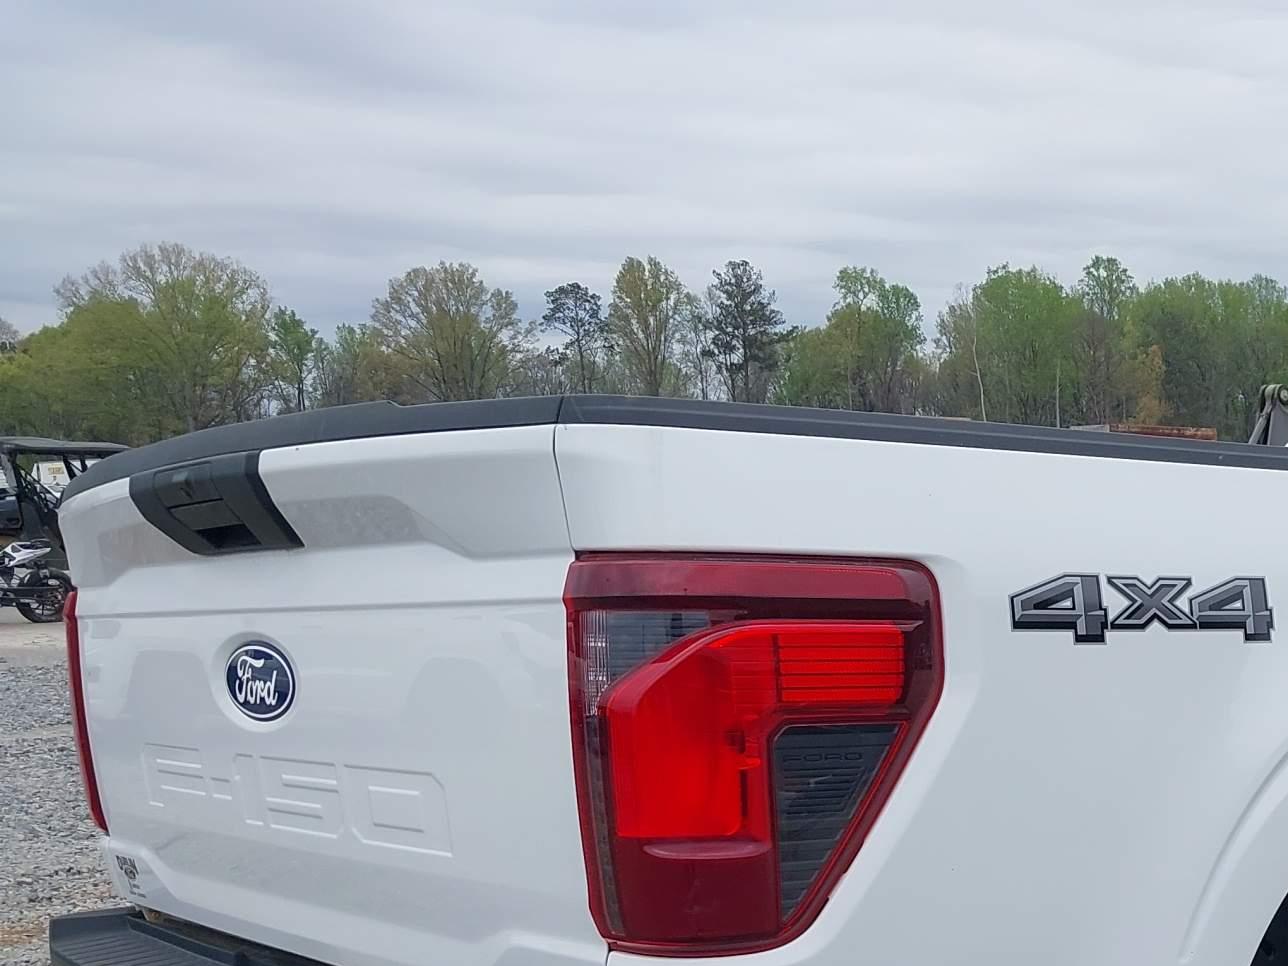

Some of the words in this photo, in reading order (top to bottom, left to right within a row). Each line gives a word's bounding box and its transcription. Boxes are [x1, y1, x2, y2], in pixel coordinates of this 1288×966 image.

[1009, 573, 1275, 645] 4X4
[236, 655, 278, 706] Ford
[141, 742, 454, 857] F-150
